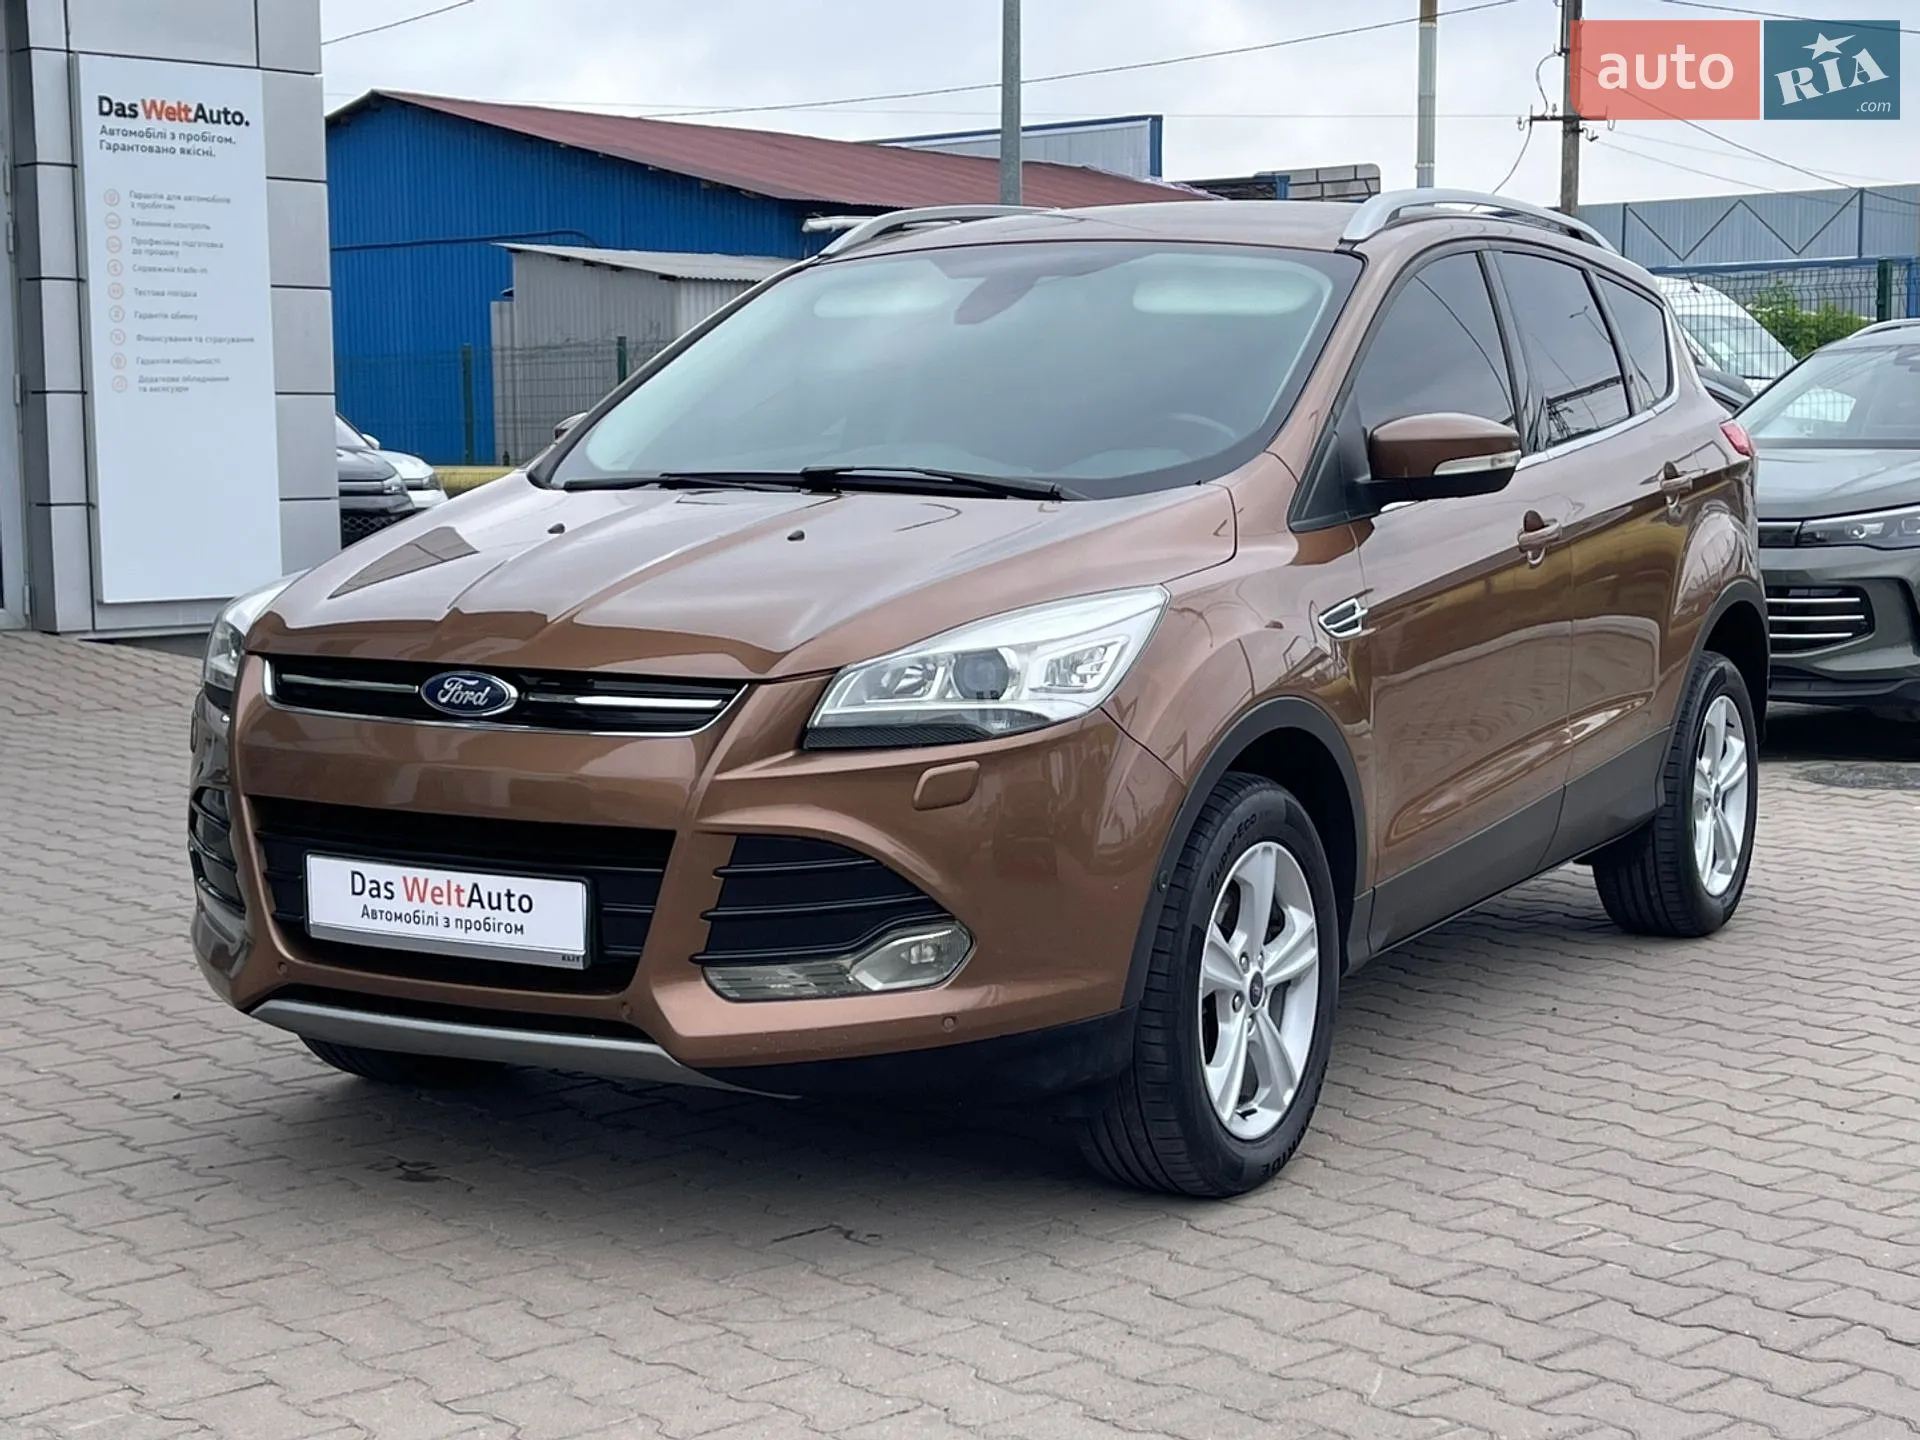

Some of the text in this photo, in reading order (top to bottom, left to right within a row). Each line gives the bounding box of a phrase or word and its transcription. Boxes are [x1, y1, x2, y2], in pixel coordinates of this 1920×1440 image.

[98, 95, 250, 127] Das WeltAuto.
[99, 124, 237, 145] Автомобілі з пробігом.
[99, 138, 216, 158] Гарантовано якісні.
[437, 677, 491, 706] Ford
[350, 870, 534, 914] Das WeltAuto
[360, 903, 524, 935] Автомобілі з пробігом
